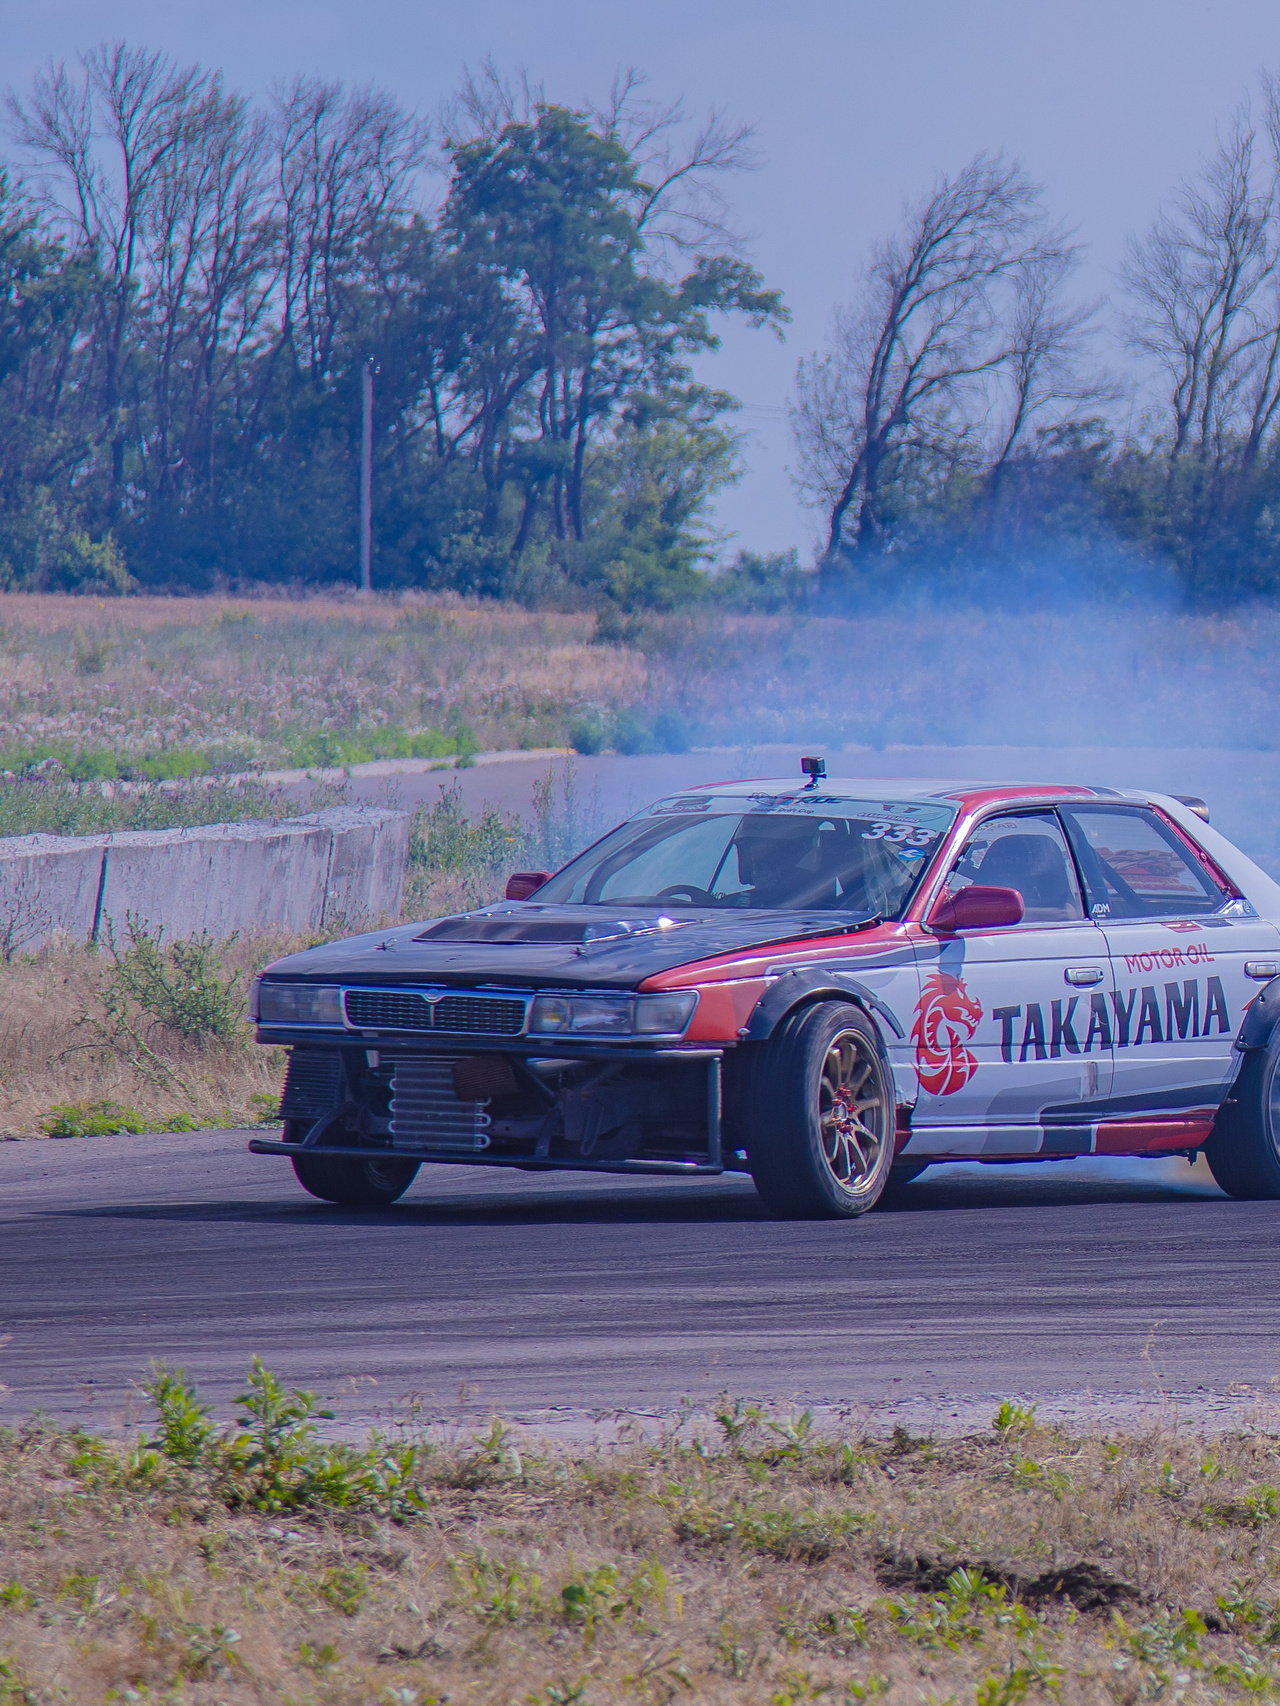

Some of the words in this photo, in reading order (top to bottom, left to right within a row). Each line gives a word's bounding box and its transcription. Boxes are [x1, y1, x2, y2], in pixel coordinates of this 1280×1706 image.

[861, 822, 937, 846] 333
[1091, 903, 1111, 914] ADM
[1123, 947, 1185, 974] MOTOR
[1185, 943, 1215, 965] OIL
[992, 975, 1231, 1064] TAKAYAMA
